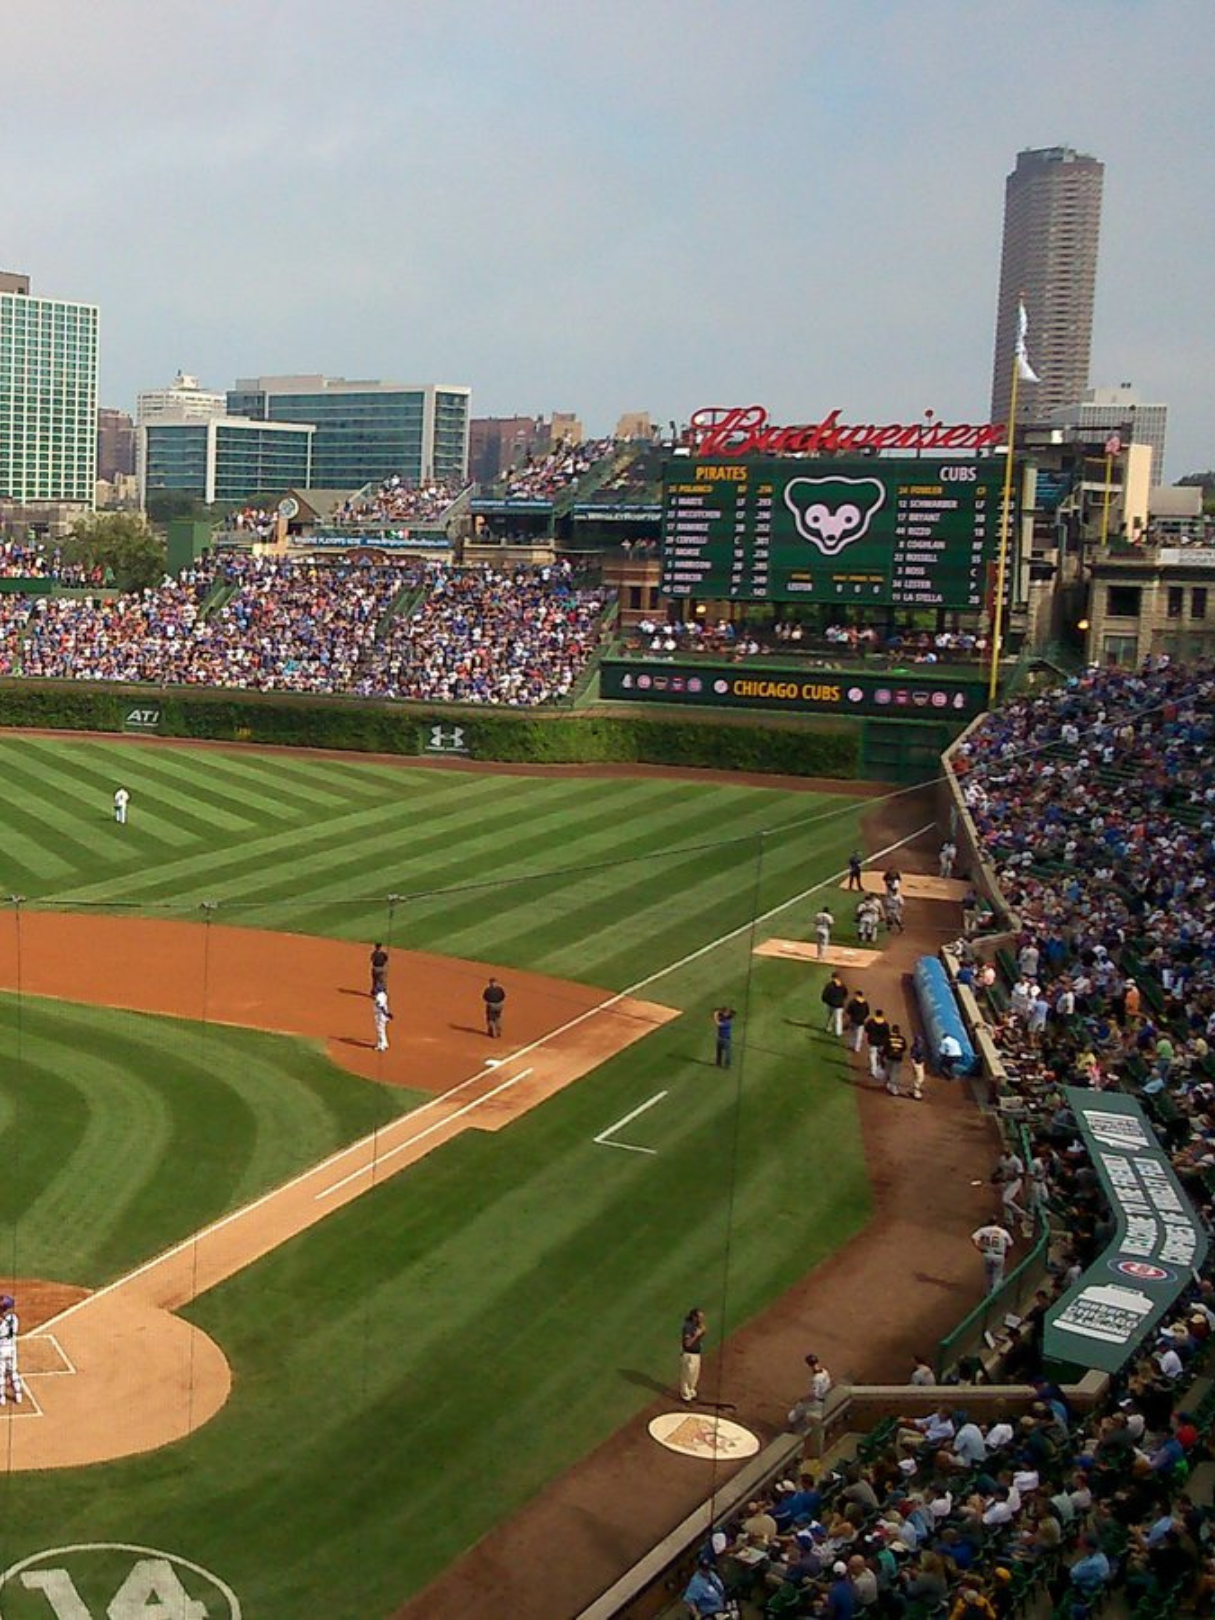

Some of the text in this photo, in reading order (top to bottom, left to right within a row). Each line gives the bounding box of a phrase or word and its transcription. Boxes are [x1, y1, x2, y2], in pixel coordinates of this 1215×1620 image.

[690, 405, 1008, 459] Budweiser
[696, 466, 748, 480] PIRATES
[939, 466, 977, 481] CUBS
[733, 680, 841, 702] CHICAGO CUBS
[127, 709, 160, 722] ATI
